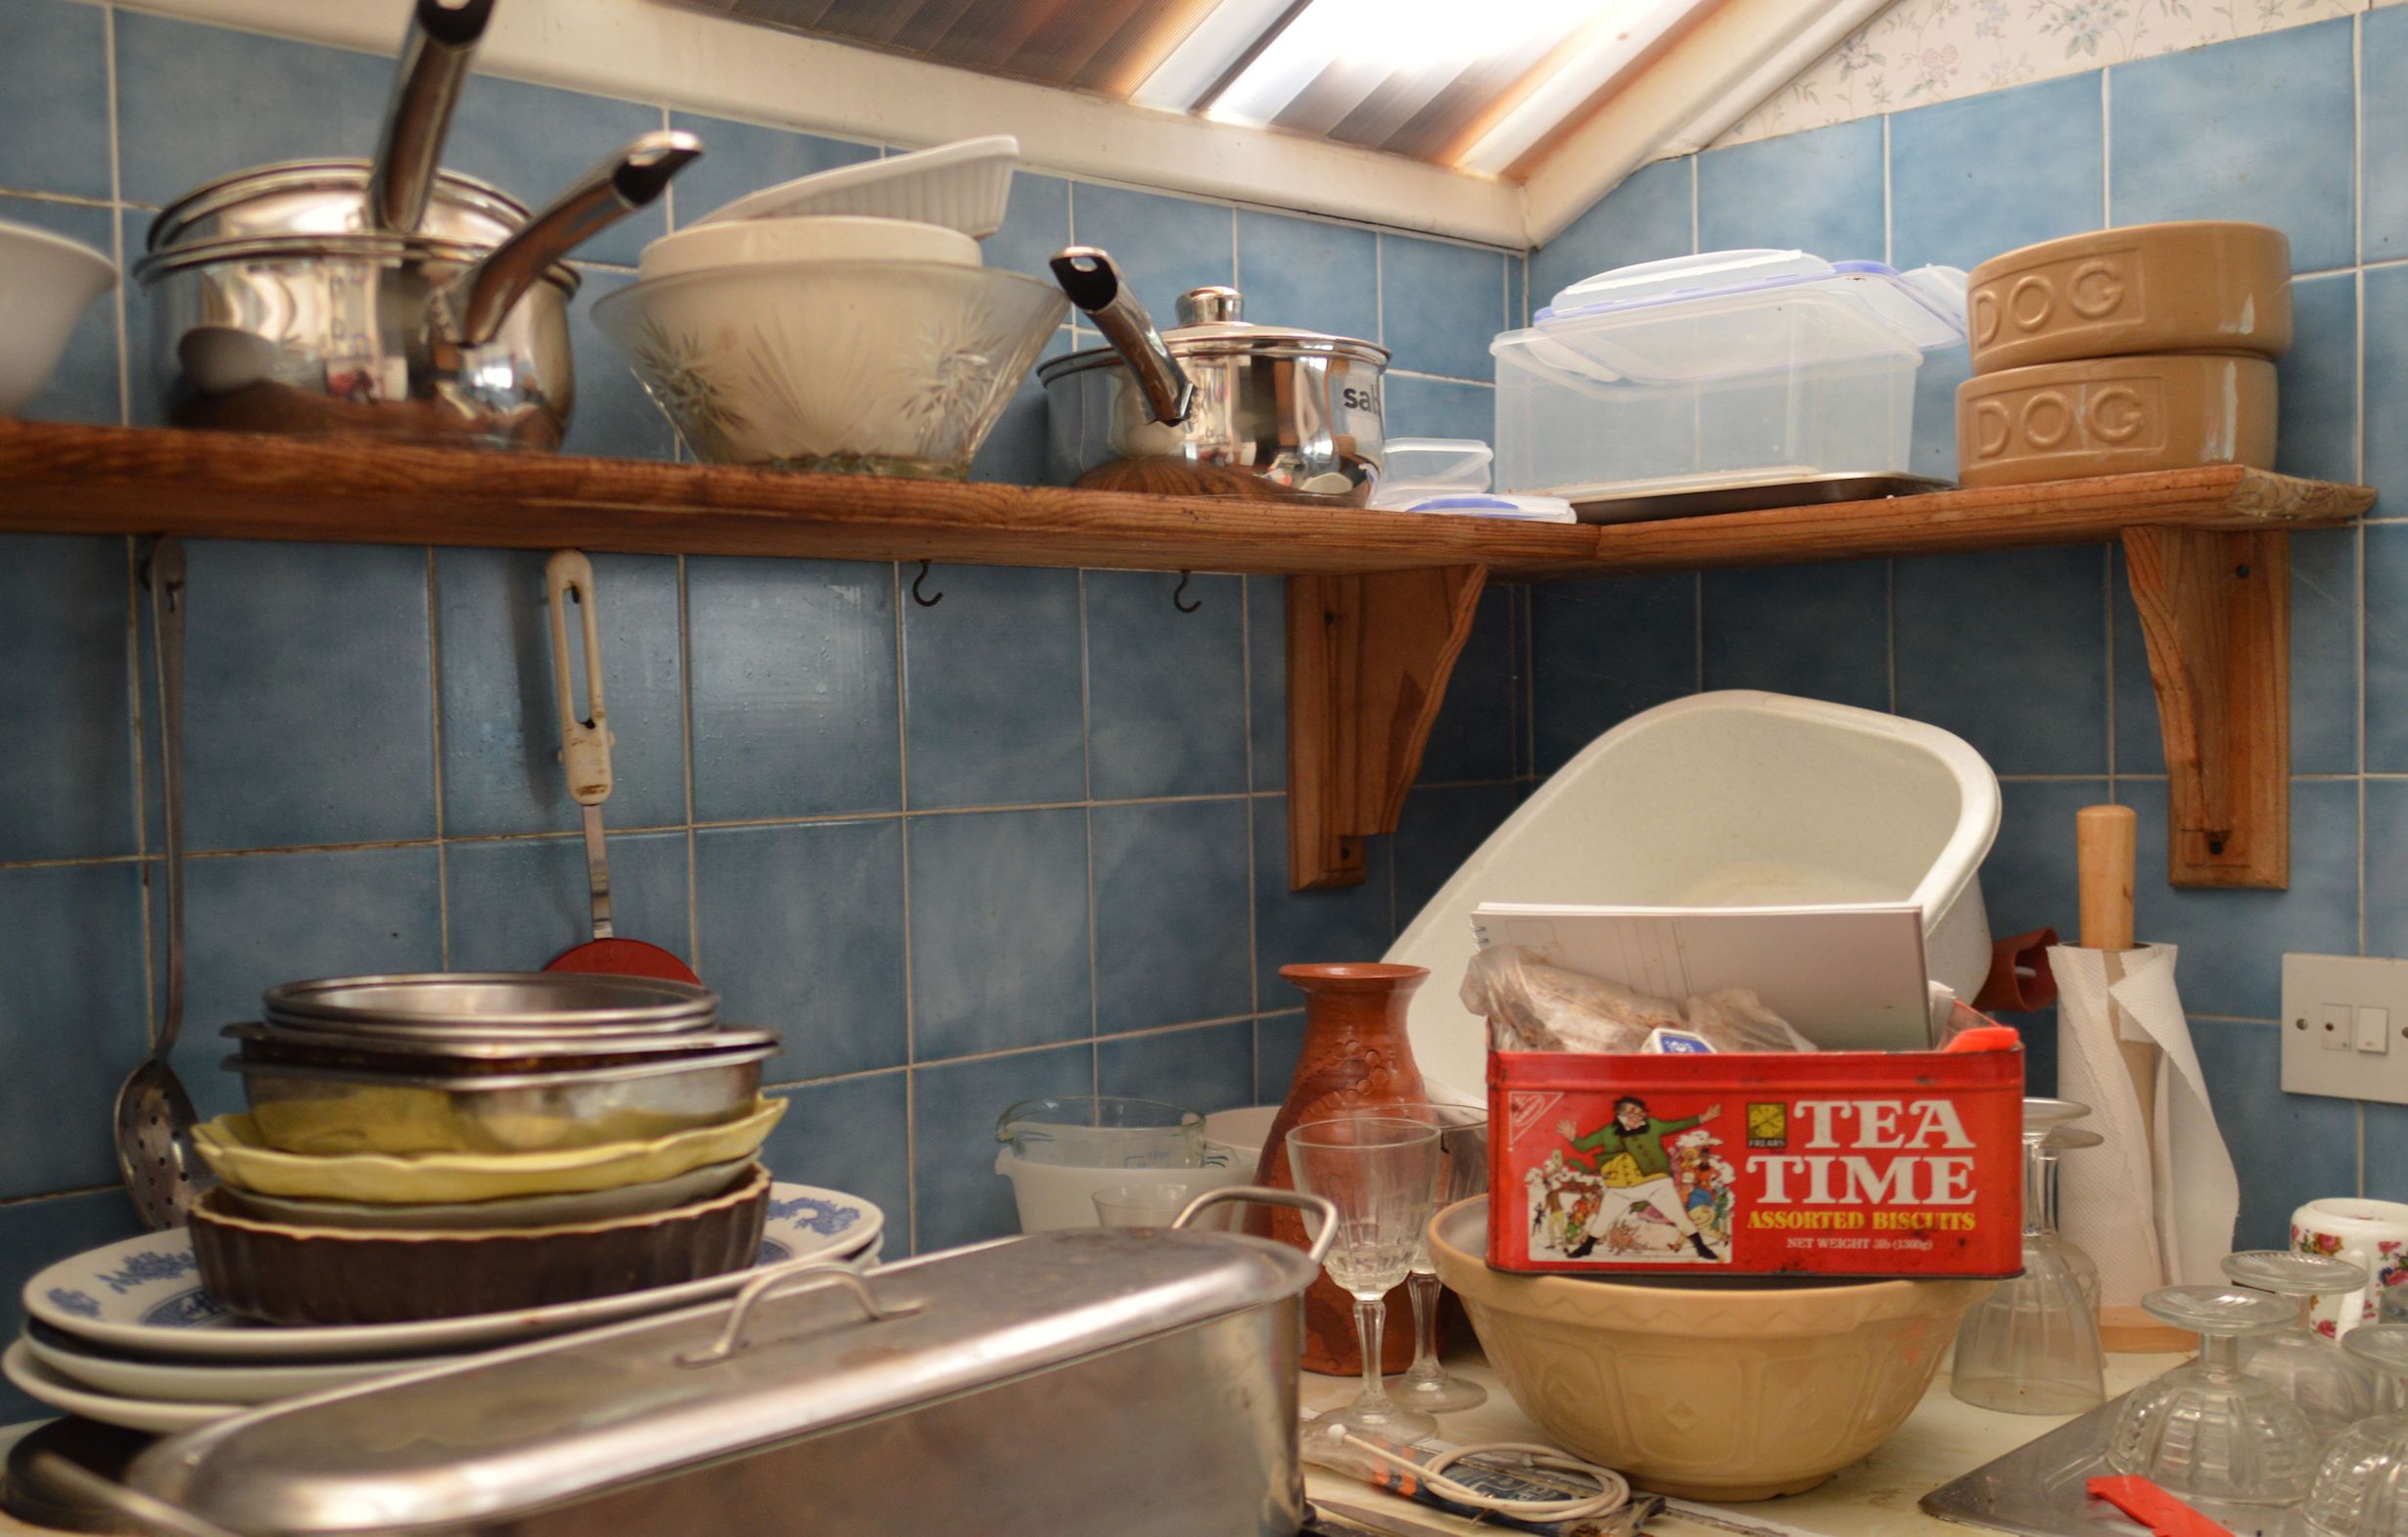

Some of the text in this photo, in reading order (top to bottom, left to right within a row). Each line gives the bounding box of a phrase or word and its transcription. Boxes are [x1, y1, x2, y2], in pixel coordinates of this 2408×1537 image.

[1973, 260, 2124, 349] DOG
[1975, 386, 2143, 459] DOG
[1793, 1100, 1976, 1148] TEA
[1745, 1156, 1977, 1205] TIME
[1747, 1211, 1976, 1231] ASSORTED BISCUITS
[1787, 1237, 1814, 1249] NET
[1817, 1237, 1870, 1249] WEIGHT
